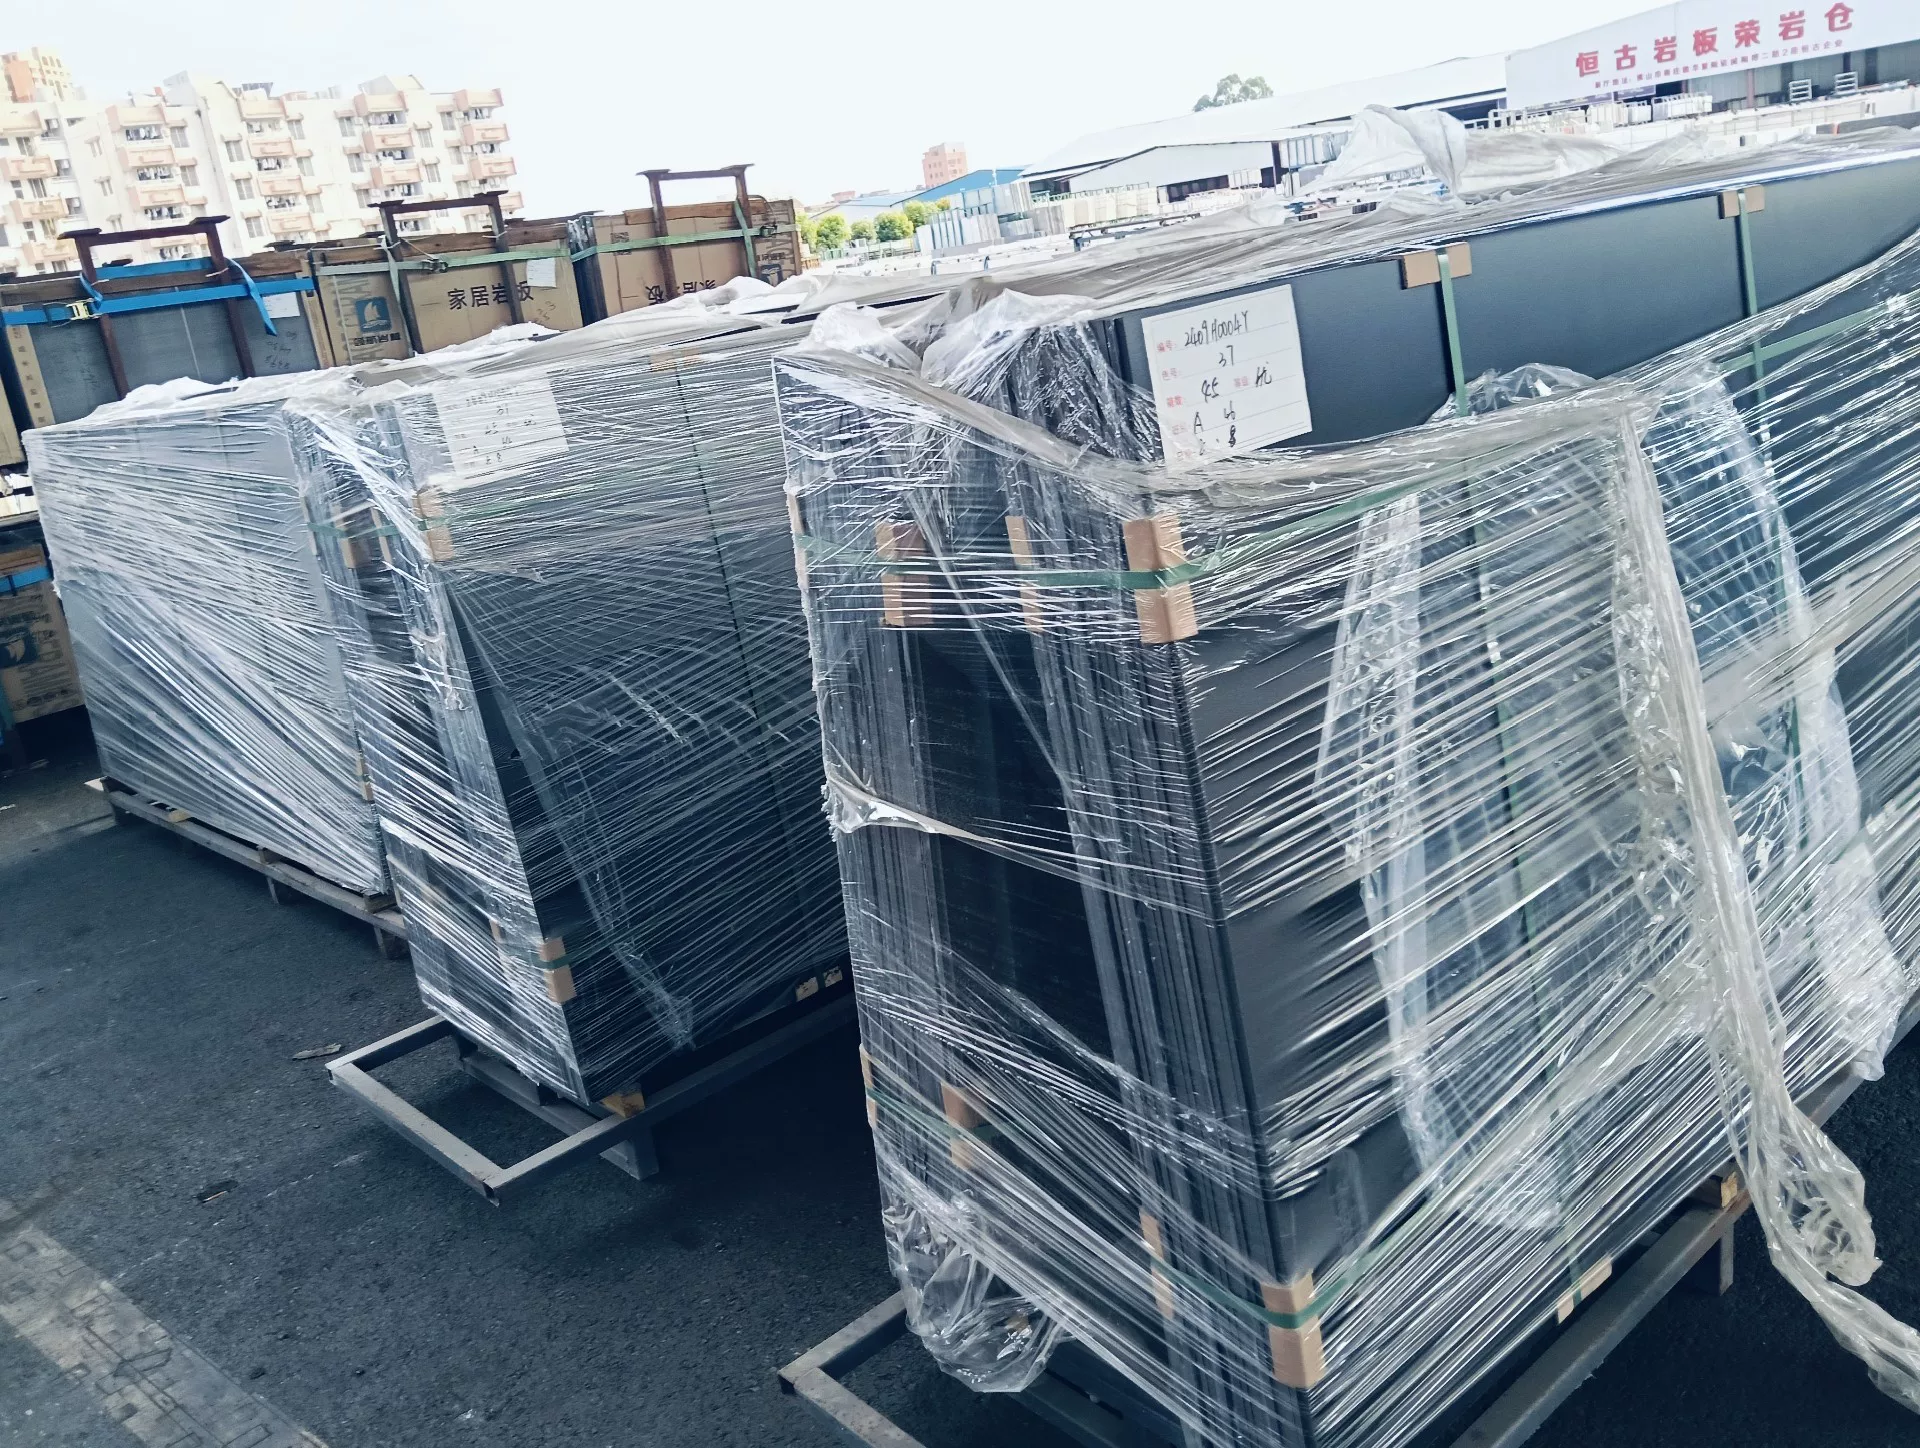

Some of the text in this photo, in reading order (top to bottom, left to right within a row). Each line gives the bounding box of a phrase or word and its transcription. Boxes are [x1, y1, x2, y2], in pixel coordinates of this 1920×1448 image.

[1576, 2, 1854, 78] 恒古岩板荣岩仓
